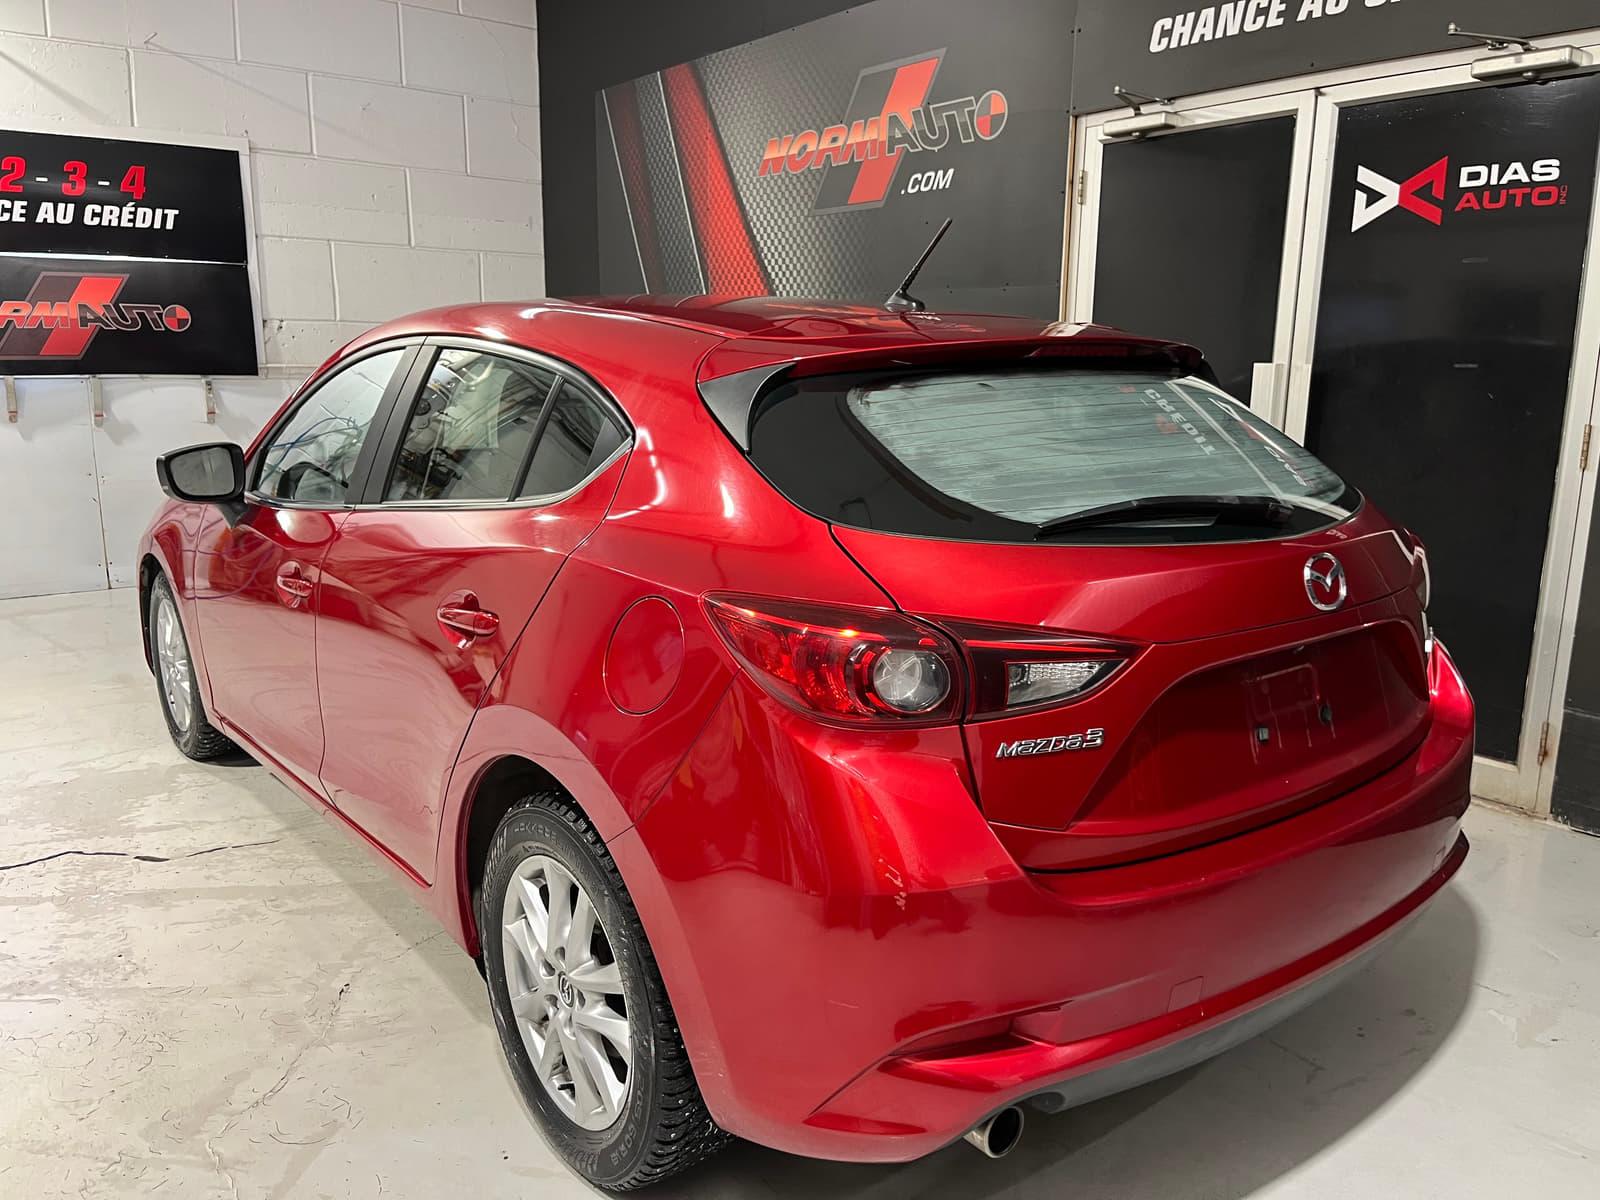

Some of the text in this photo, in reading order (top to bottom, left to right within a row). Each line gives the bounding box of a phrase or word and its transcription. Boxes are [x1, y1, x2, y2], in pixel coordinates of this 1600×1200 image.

[1149, 0, 1287, 53] CHANCE
[0, 156, 27, 193] 2
[61, 160, 88, 196] 3
[119, 165, 147, 200] 4
[901, 168, 955, 195] .COM
[1459, 158, 1561, 188] DIAS
[1454, 185, 1559, 212] AUTO
[1559, 184, 1568, 205] INC
[35, 201, 75, 225] AU
[83, 202, 180, 230] CRÉDIT
